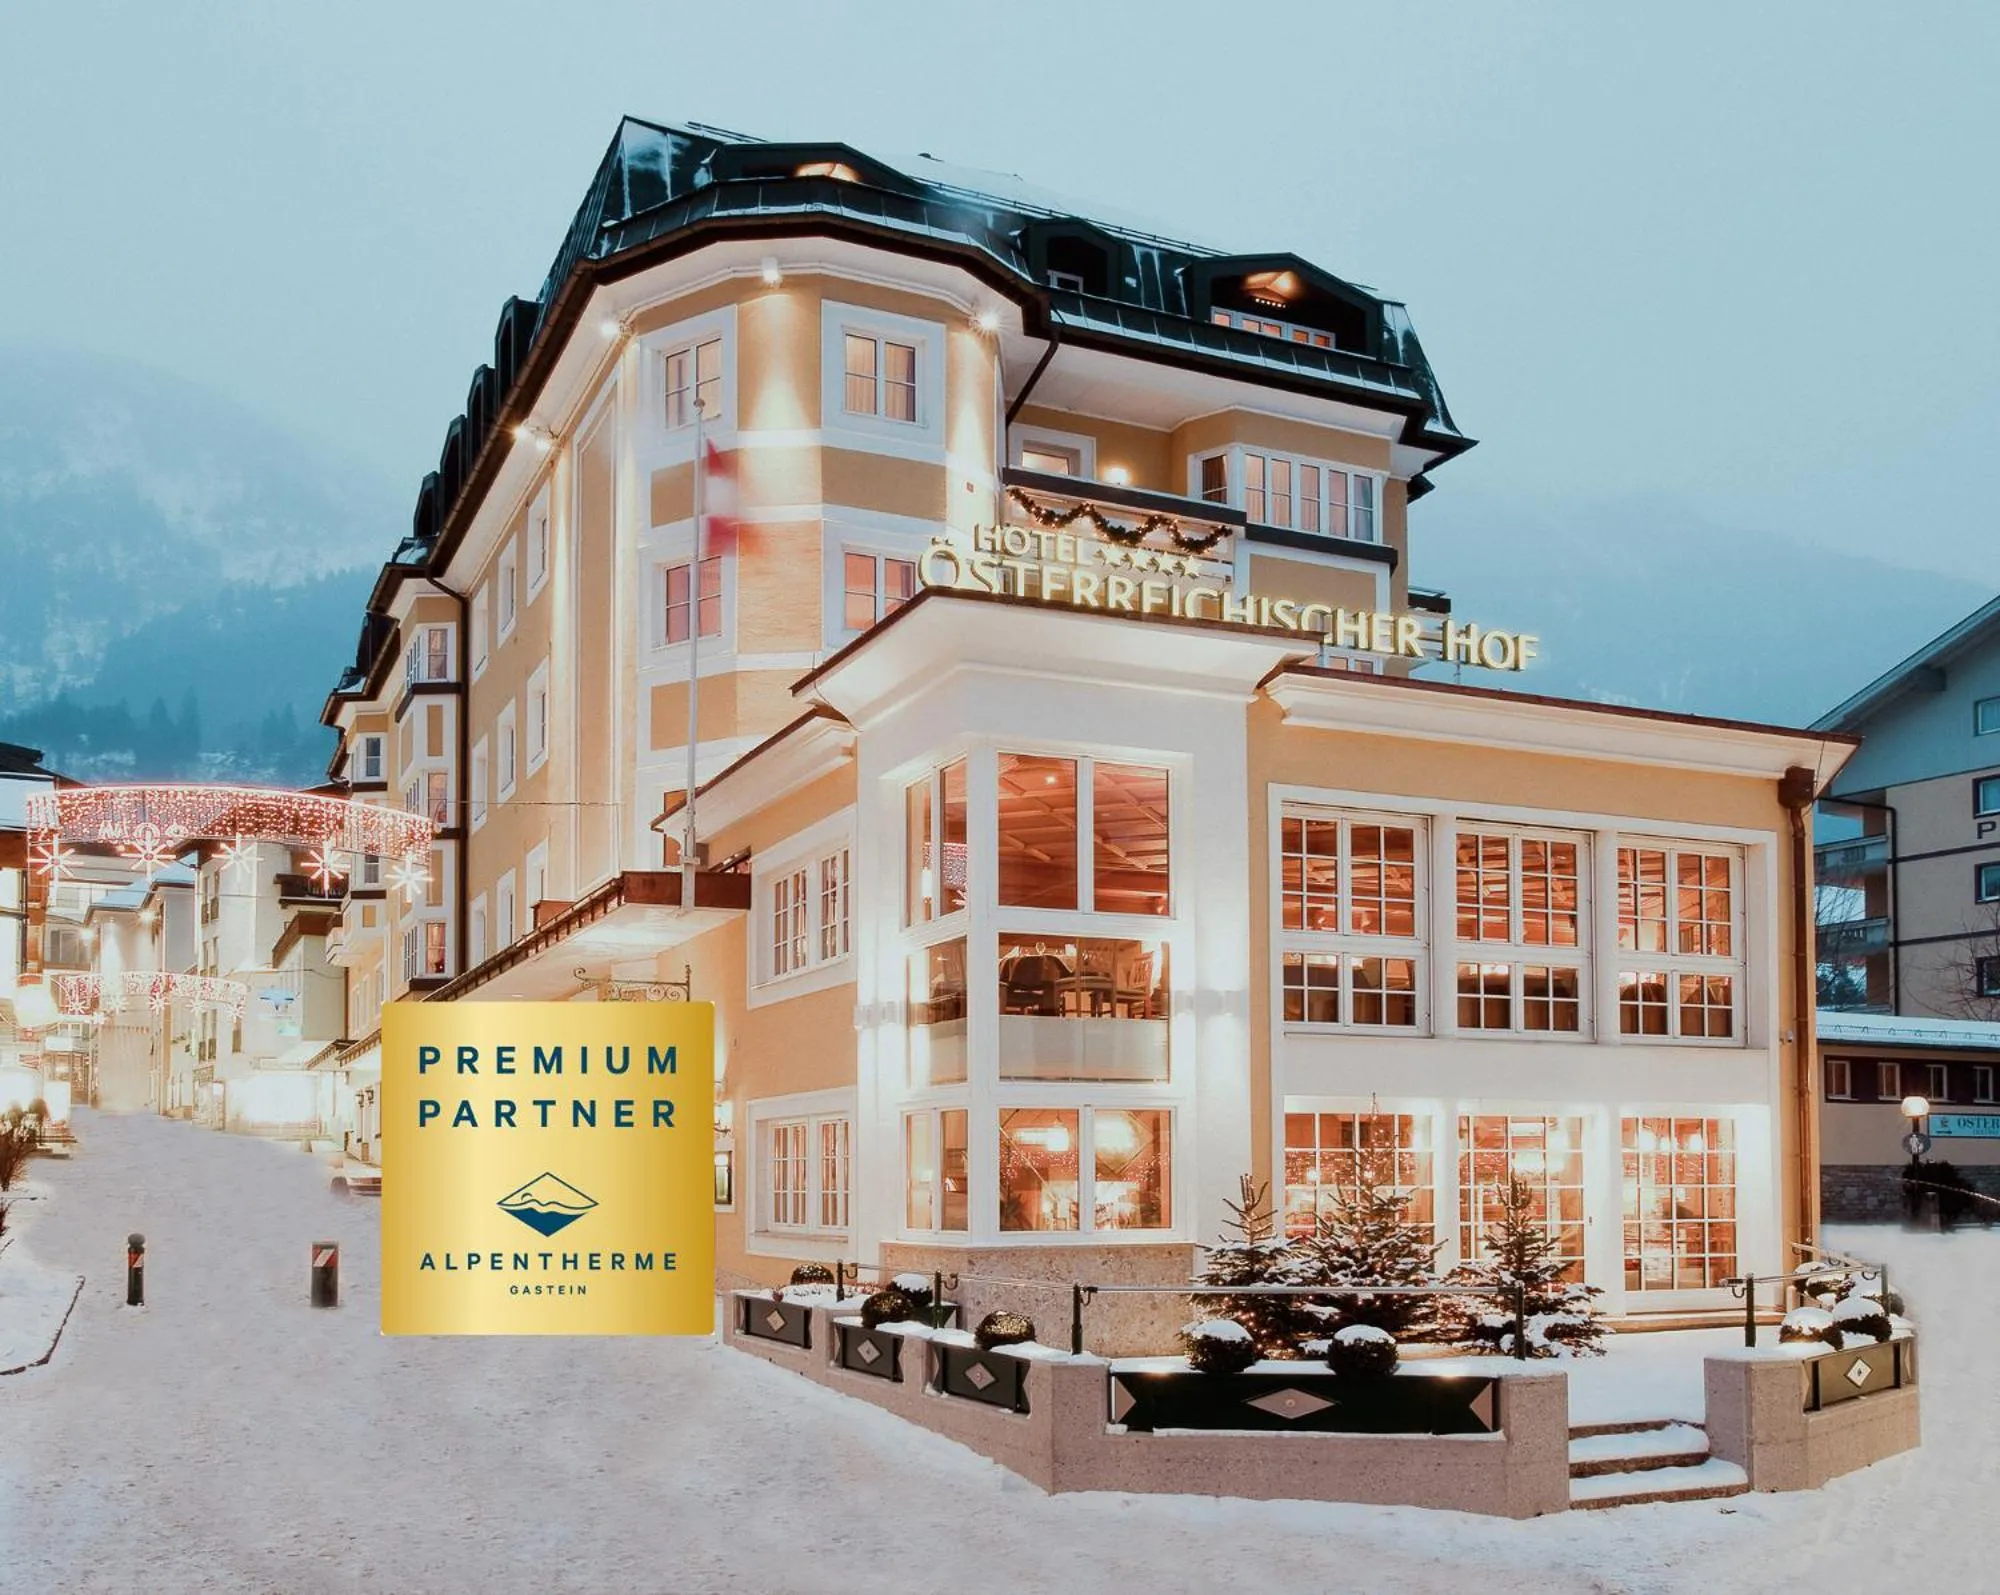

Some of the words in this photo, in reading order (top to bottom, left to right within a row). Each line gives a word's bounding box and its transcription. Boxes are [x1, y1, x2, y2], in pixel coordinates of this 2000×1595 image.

[973, 523, 1095, 567] HOTEL
[918, 535, 1425, 658] ÖSTERREICHISCHER
[1441, 618, 1540, 671] HOF
